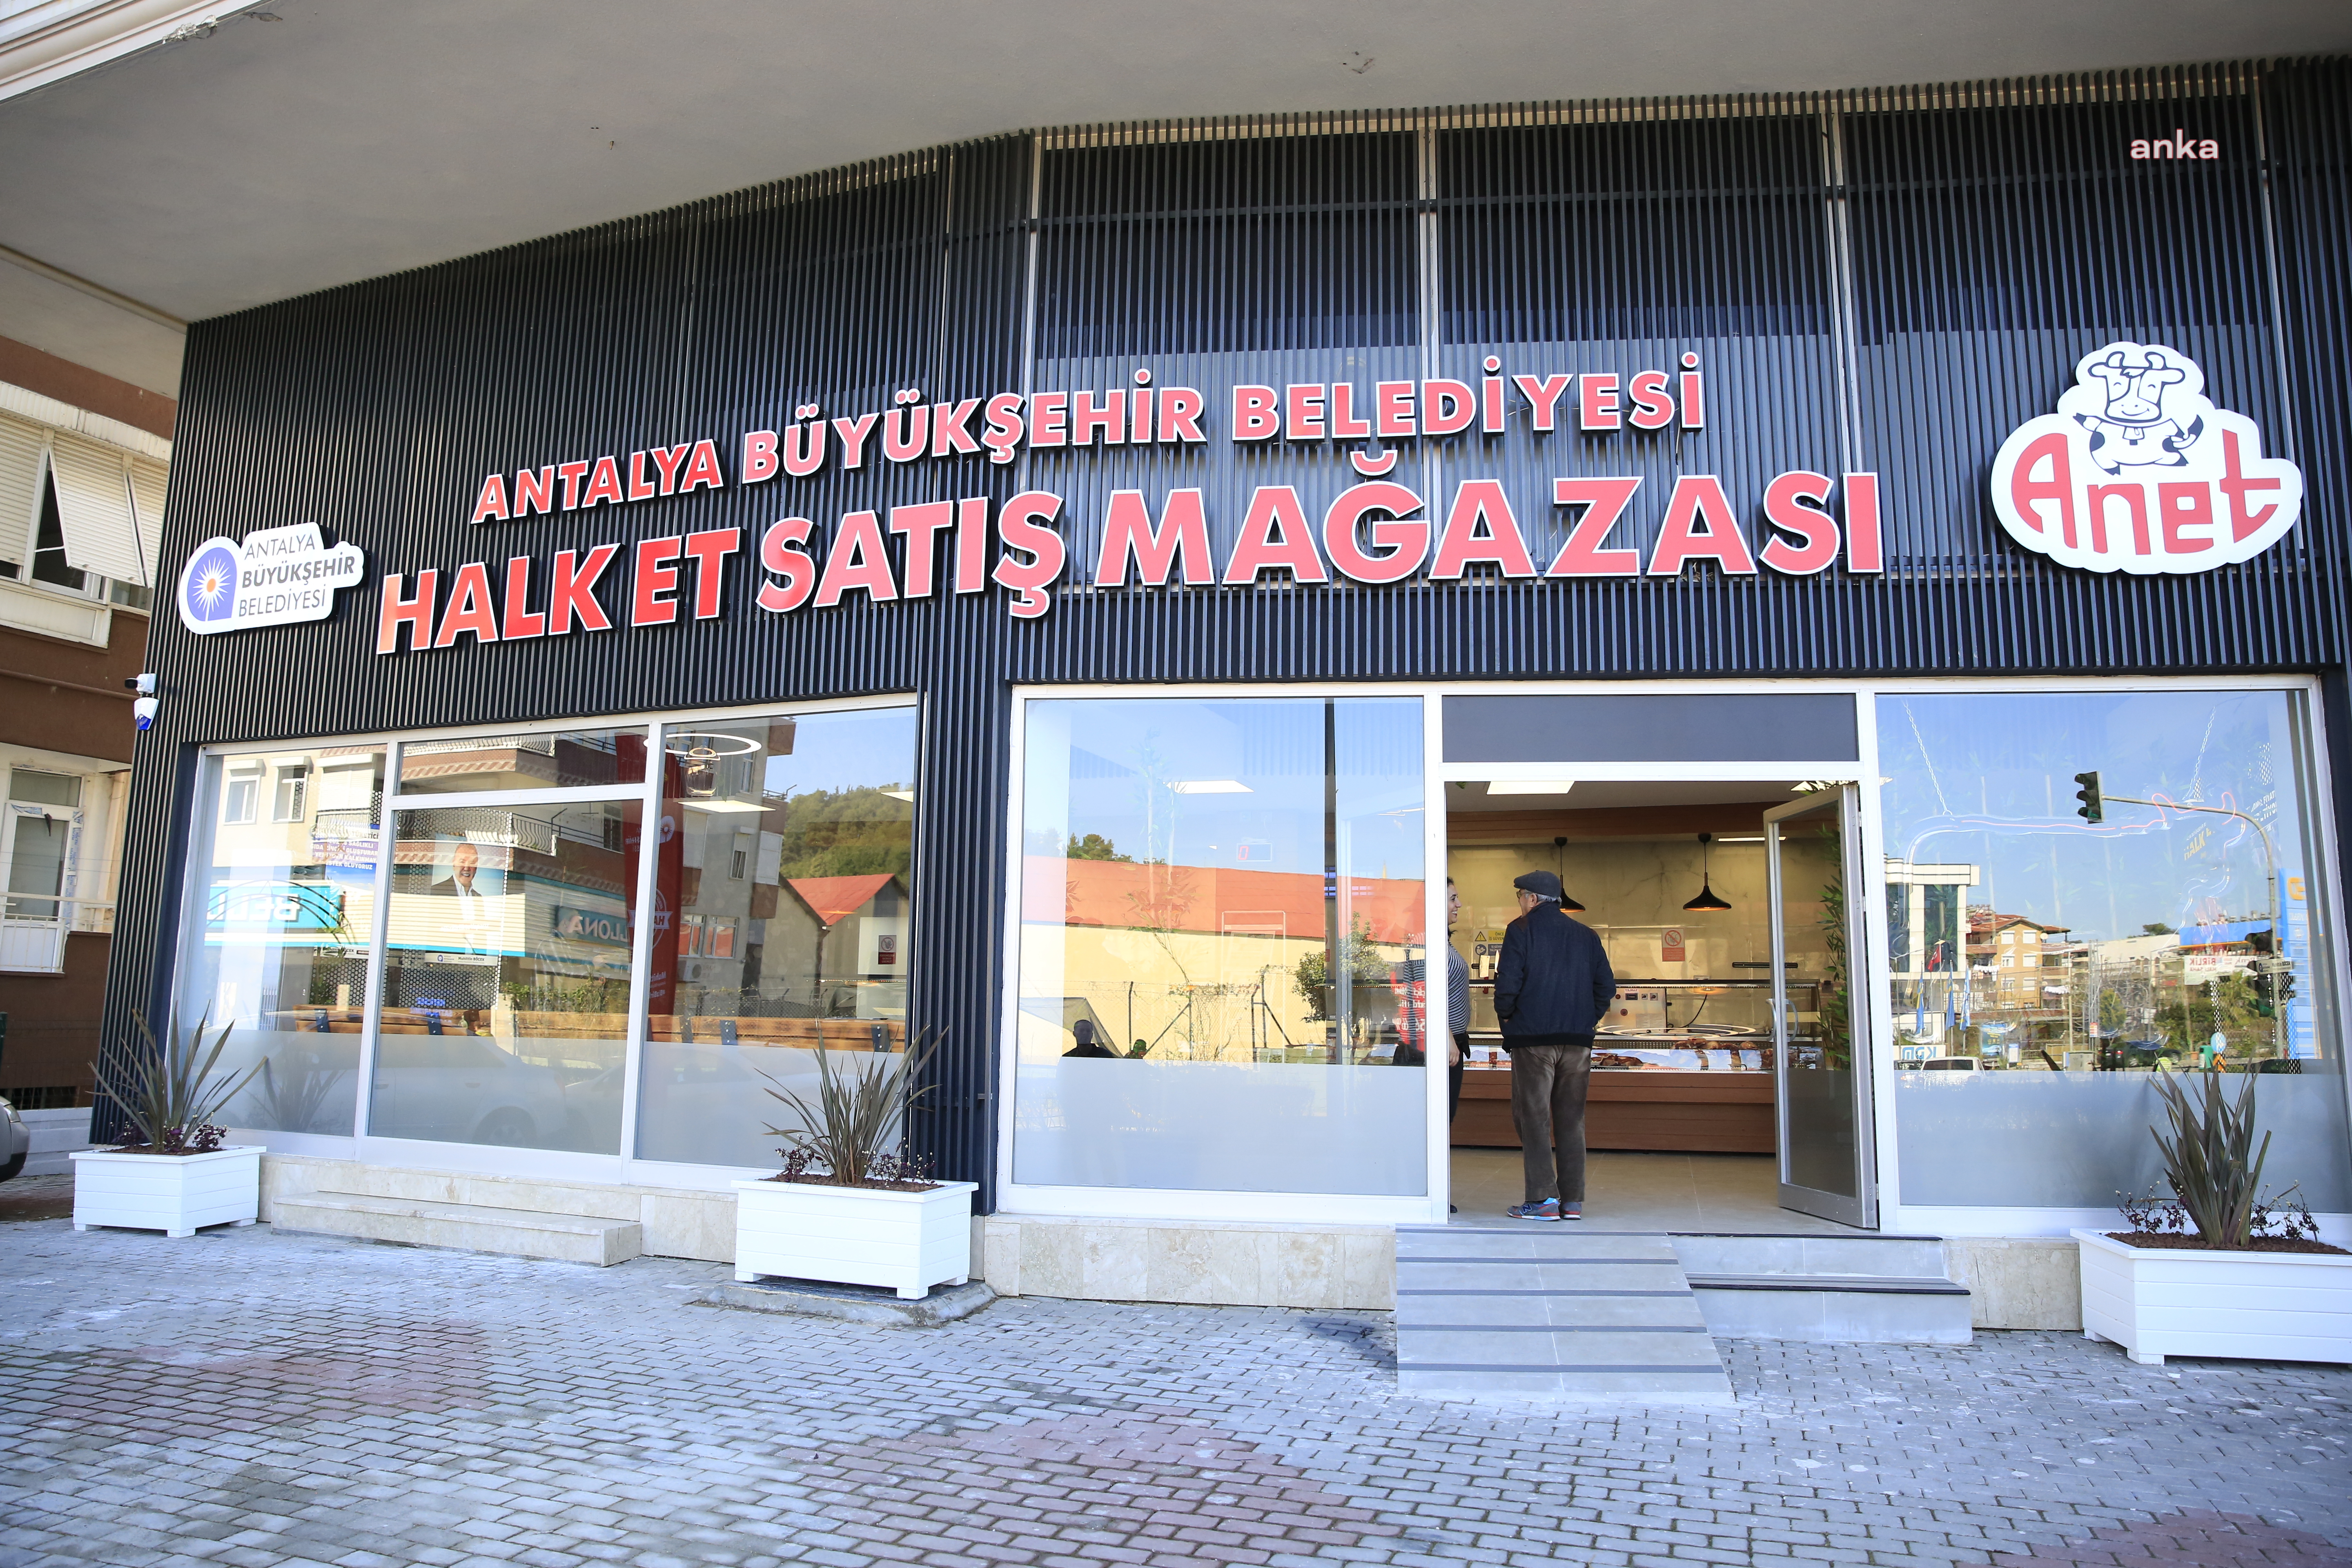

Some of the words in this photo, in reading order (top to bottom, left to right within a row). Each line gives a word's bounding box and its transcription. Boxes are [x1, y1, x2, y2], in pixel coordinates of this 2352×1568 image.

[471, 438, 724, 524] ANTALYA
[741, 368, 1207, 484] BÜYÜKŞEHİR
[1232, 351, 1704, 441] BELEDİYESİ
[2011, 429, 2281, 555] Anet
[244, 533, 315, 560] ANTALYA
[376, 543, 621, 655] HALK
[630, 527, 741, 627] ET
[755, 490, 1067, 618] SATIŞ
[1094, 449, 1884, 587] MAĞAZASI
[242, 552, 355, 588] BÜYÜKŞEHİR
[238, 584, 326, 617] BELEDİYESİ
[344, 862, 373, 870] OLUYORUZ
[1238, 845, 1249, 860] 0
